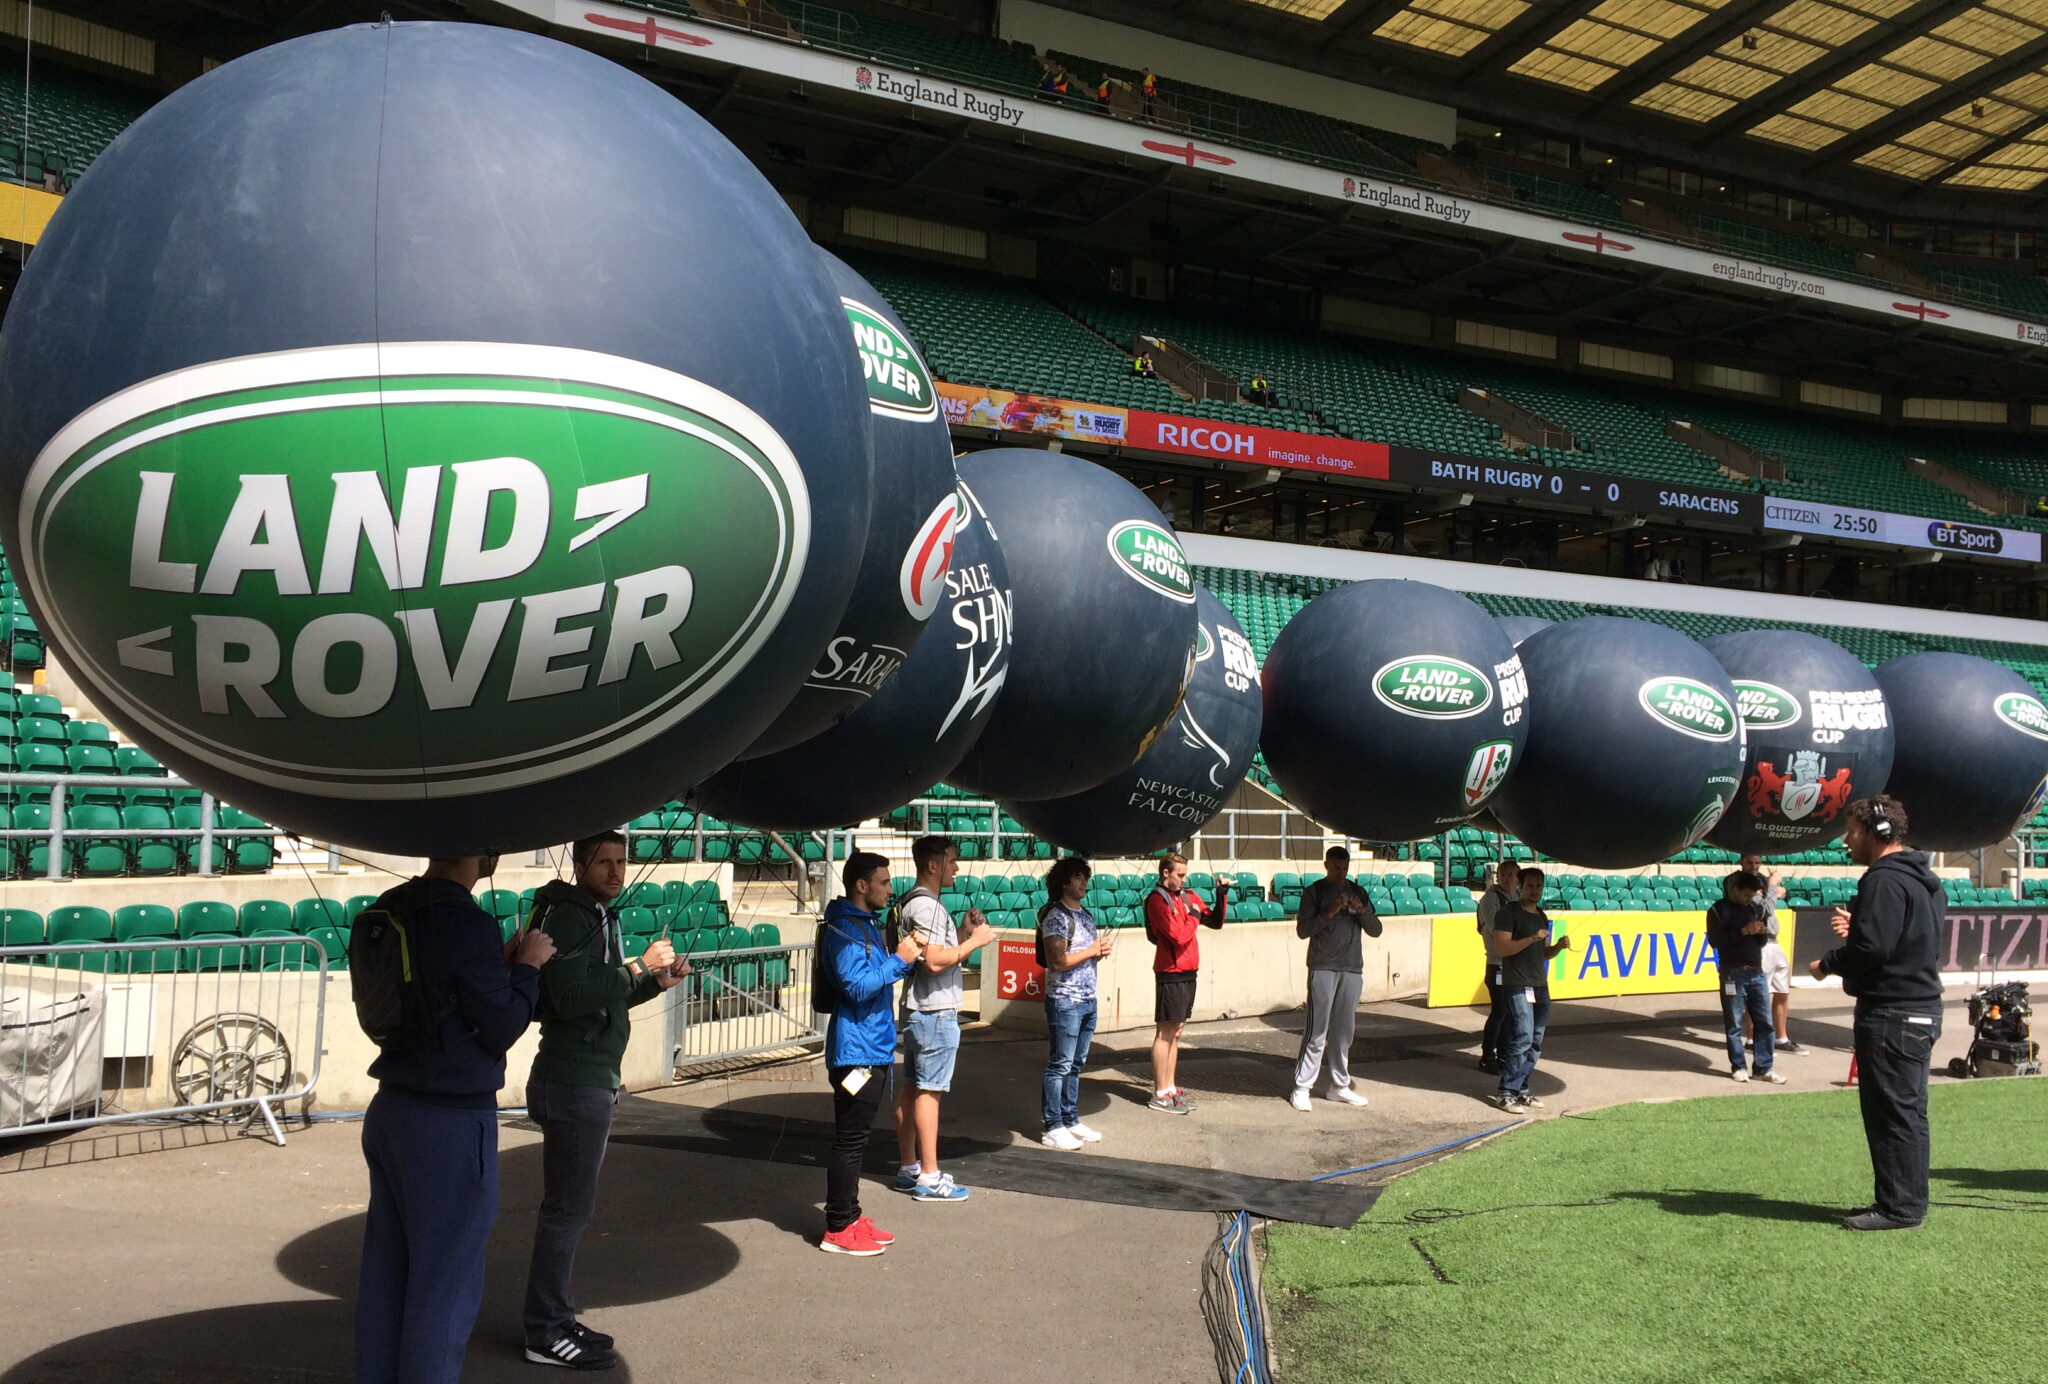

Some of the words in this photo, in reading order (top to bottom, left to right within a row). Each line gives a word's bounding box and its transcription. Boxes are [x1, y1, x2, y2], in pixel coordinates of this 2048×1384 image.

[877, 72, 958, 108] England
[963, 92, 1024, 126] Rugby
[1358, 181, 1421, 210] England
[1424, 195, 1471, 224] Rugby
[1713, 262, 1825, 295] englandrugby.com
[853, 321, 894, 357] ND
[859, 349, 921, 401] OVER
[941, 396, 968, 414] NS
[1158, 423, 1255, 456] RICOH
[1268, 447, 1313, 465] imagine.
[1316, 454, 1357, 470] change.
[1431, 460, 1479, 482] BATH
[1484, 468, 1543, 490] RUGBY
[1551, 475, 1563, 494] 0
[1607, 483, 1620, 501] 0
[1659, 491, 1739, 515] SARACENS
[129, 456, 551, 597] LAND
[1765, 505, 1821, 524] CITIZEN
[1833, 513, 1878, 534] 25:50
[1134, 531, 1178, 562] LAND
[1936, 525, 1958, 543] BT
[1959, 529, 1996, 549] Sport
[945, 563, 993, 599] SALE
[1142, 552, 1190, 590] ROVER
[191, 564, 695, 719] ROVER
[1224, 671, 1250, 693] CUP
[1400, 667, 1456, 686] LAND
[1403, 685, 1474, 705] ROVER
[1665, 685, 1715, 713] LAND
[1738, 689, 1766, 704] ND
[2011, 699, 2043, 716] LAND
[1503, 706, 1522, 726] CUP
[1668, 701, 1726, 731] ROVER
[1810, 702, 1888, 731] RUGBY
[1812, 729, 1845, 744] CUP
[1128, 792, 1209, 824] FALCONS
[1136, 777, 1220, 810] NEWCASTLE
[1754, 823, 1822, 834] GLOUCESTER
[1768, 831, 1803, 840] RUGBY
[1002, 945, 1037, 955] ENCLOSUR
[1577, 932, 1720, 980] AVIVA
[1002, 970, 1018, 994] 3
